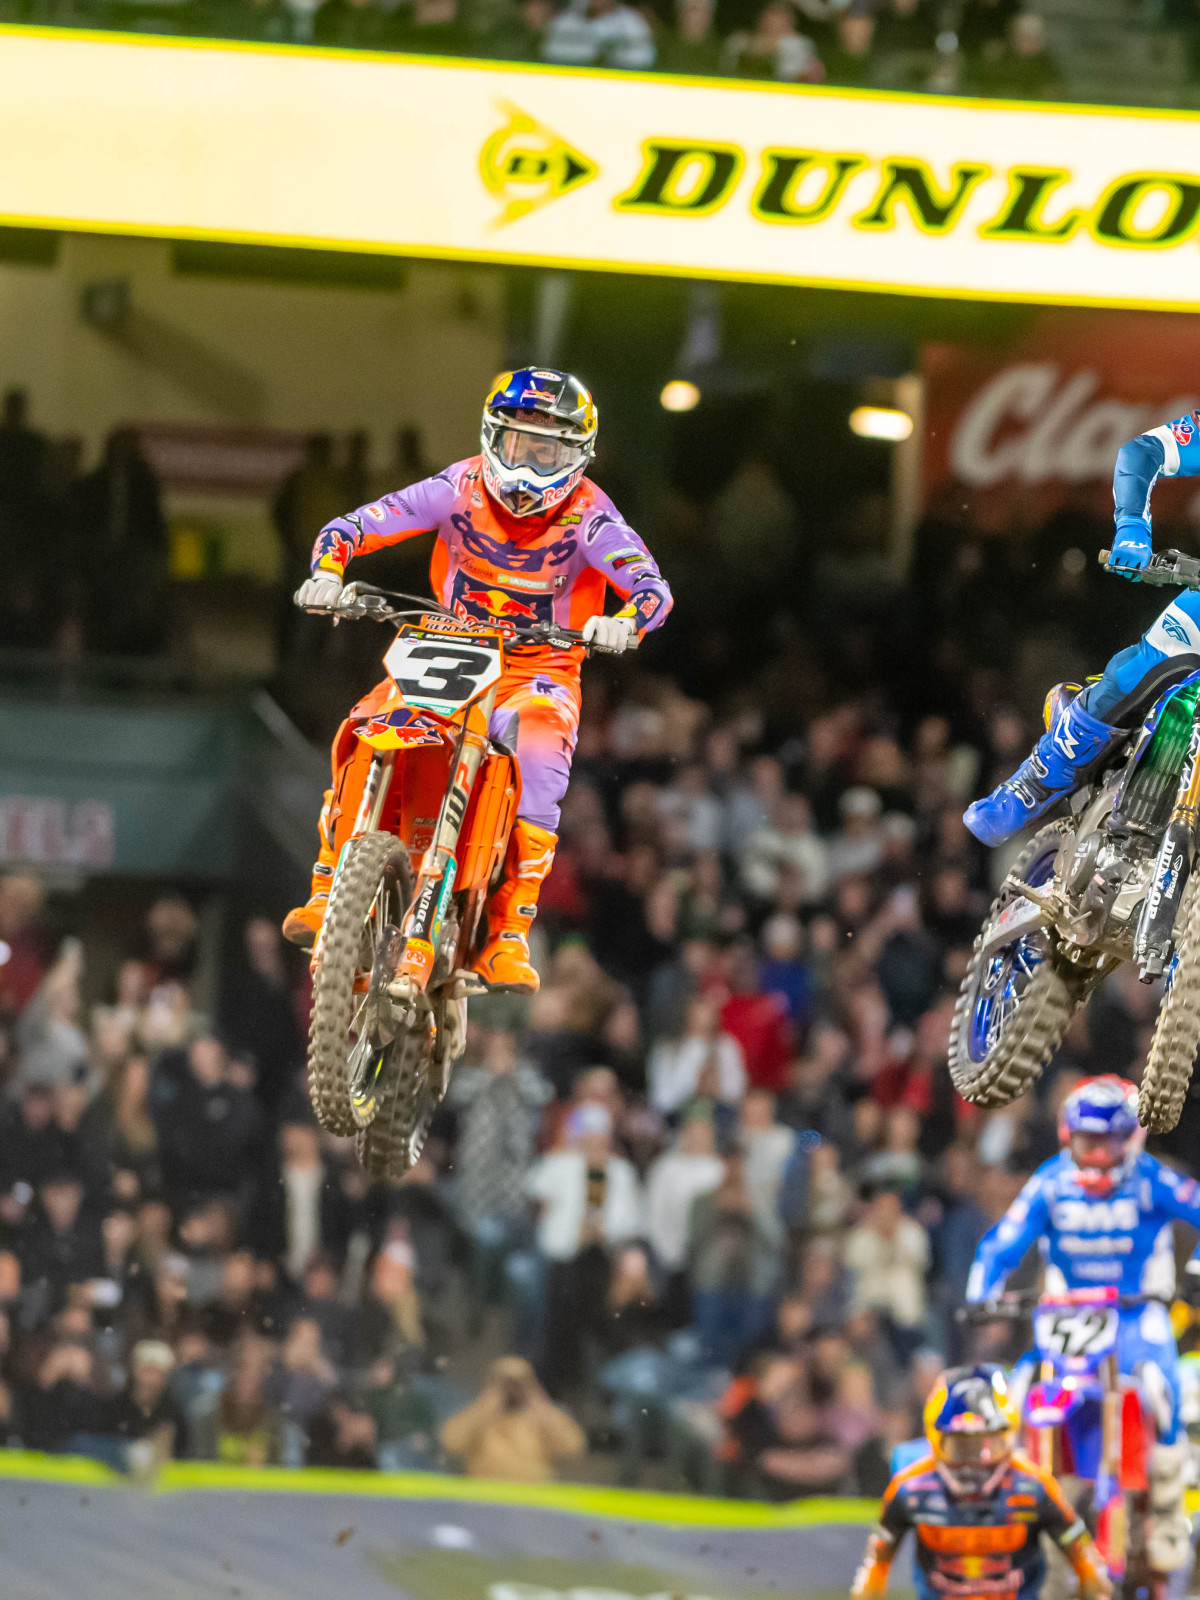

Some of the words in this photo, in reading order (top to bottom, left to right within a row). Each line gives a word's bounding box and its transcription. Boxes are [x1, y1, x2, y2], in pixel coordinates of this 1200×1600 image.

[542, 473, 574, 507] Red
[1118, 541, 1148, 549] FLY
[394, 646, 493, 701] 3
[436, 865, 457, 920] MOTOREX
[1149, 840, 1176, 920] DUNLOP
[1051, 1312, 1109, 1357] 52
